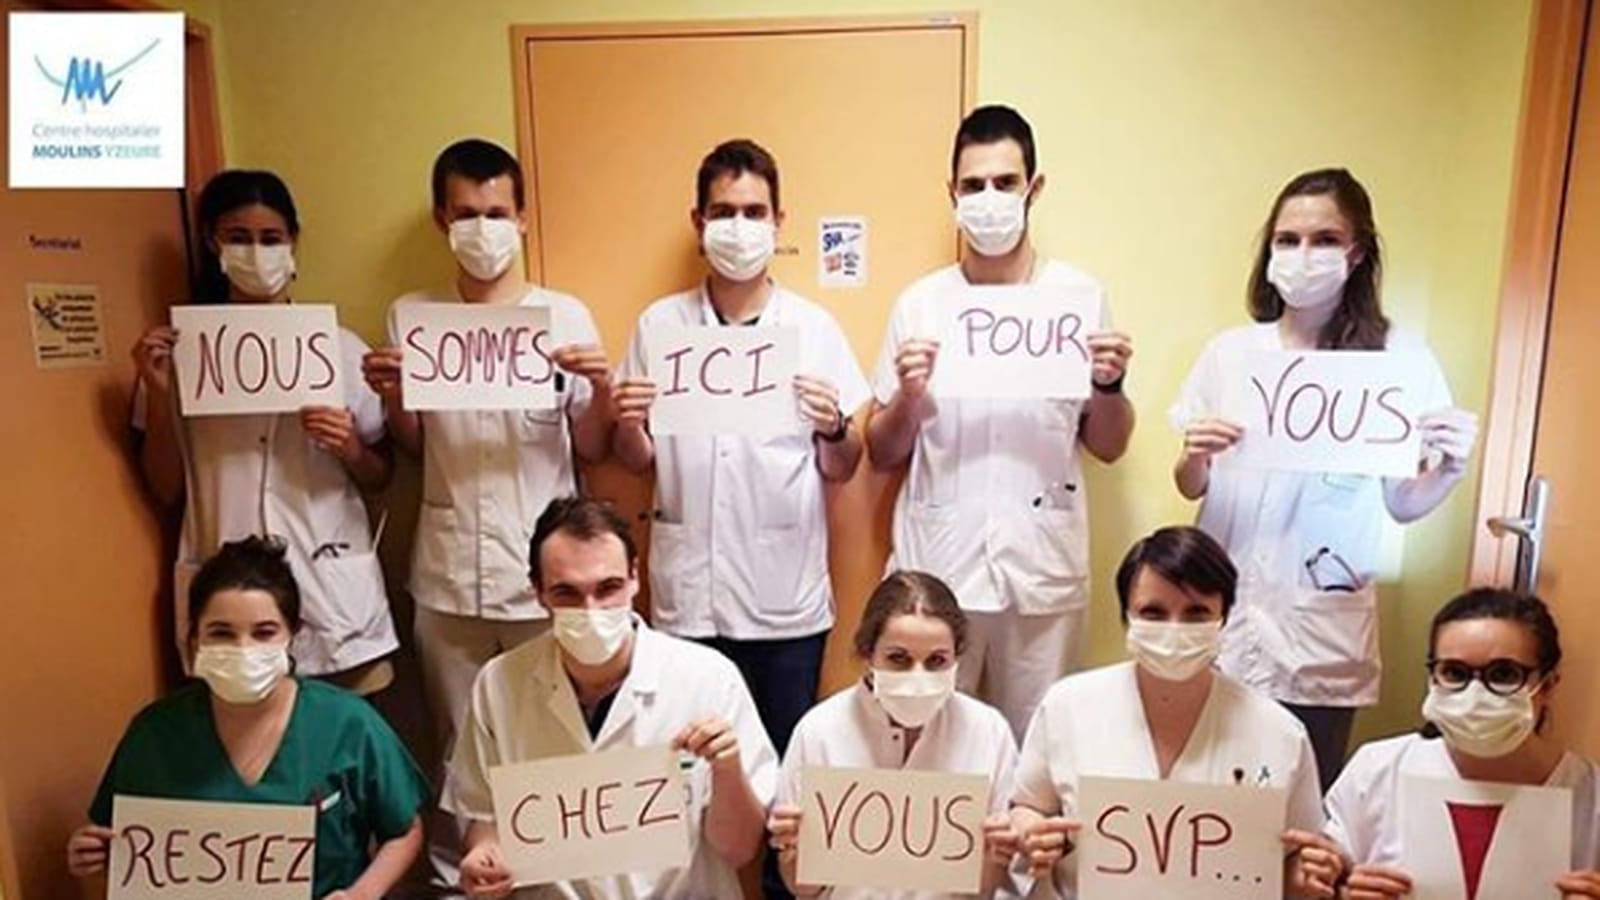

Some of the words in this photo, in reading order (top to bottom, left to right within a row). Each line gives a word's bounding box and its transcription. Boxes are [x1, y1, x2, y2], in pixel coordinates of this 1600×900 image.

[196, 325, 336, 400] NOUS
[406, 326, 554, 387] SOMMES
[957, 308, 1090, 362] POUR
[663, 343, 777, 397] ICI
[1251, 356, 1412, 444] VOUS
[510, 777, 680, 844] CHEZ
[815, 781, 975, 860] VOUS
[121, 824, 316, 888] RESTEZ
